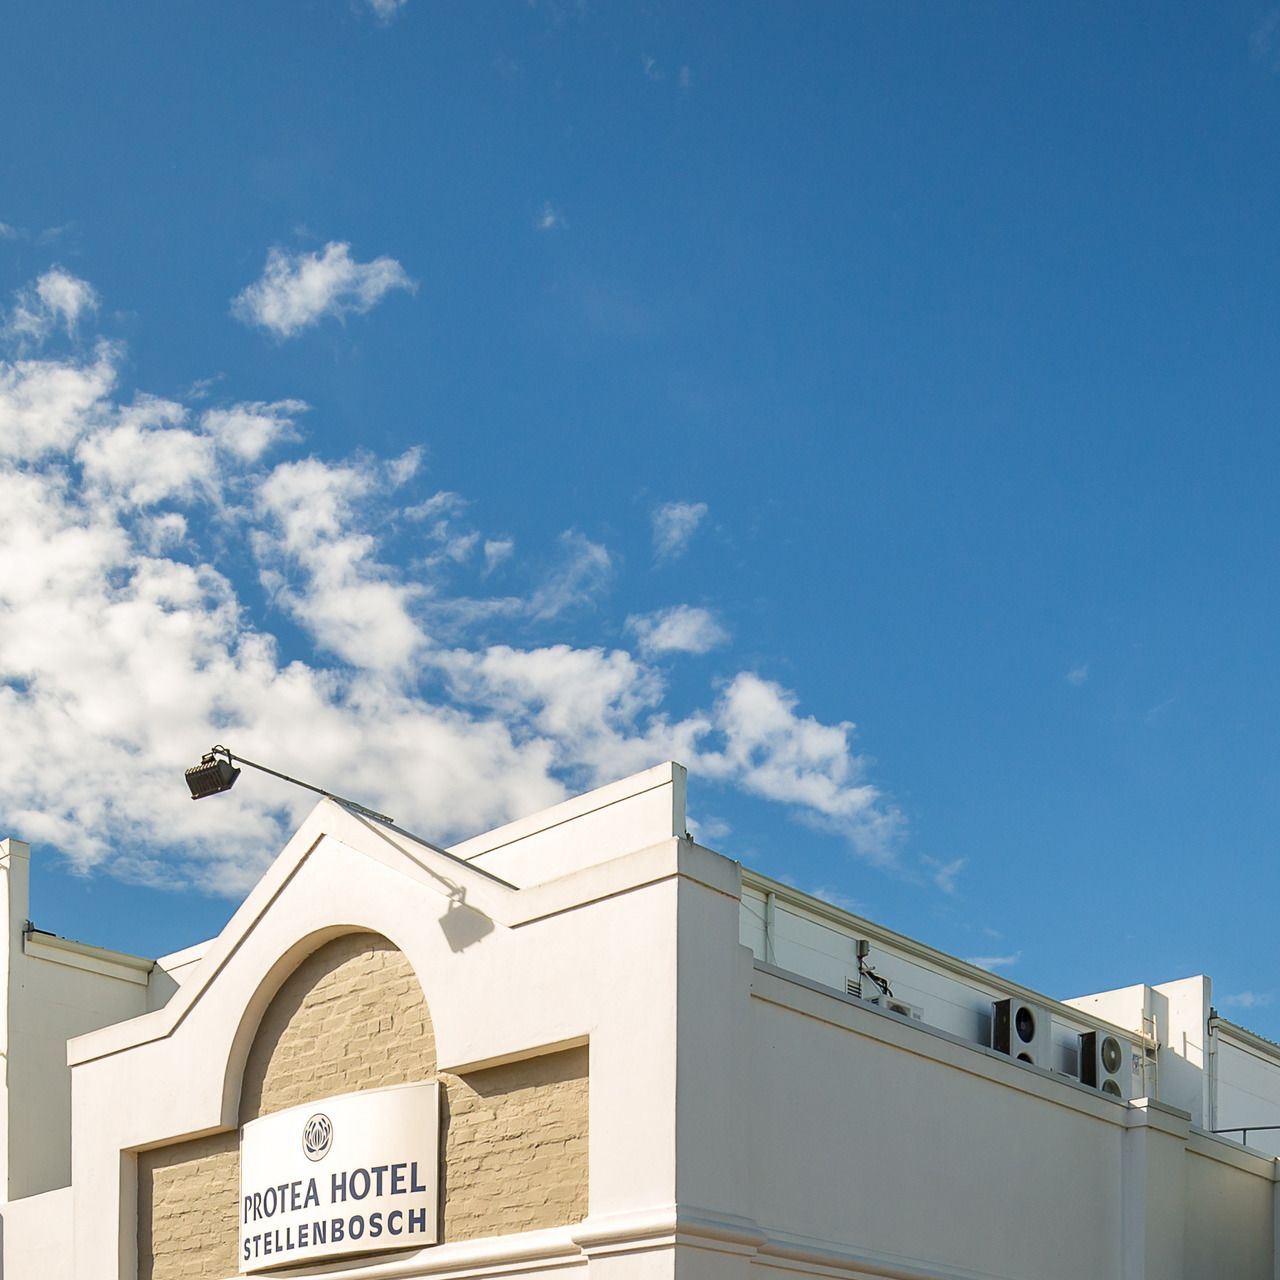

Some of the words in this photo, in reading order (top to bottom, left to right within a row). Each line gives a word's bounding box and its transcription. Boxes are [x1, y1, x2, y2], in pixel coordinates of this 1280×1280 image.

[244, 1177, 320, 1224] PROTEA
[331, 1161, 426, 1204] HOTEL
[244, 1207, 426, 1261] STELLENBOSCH
